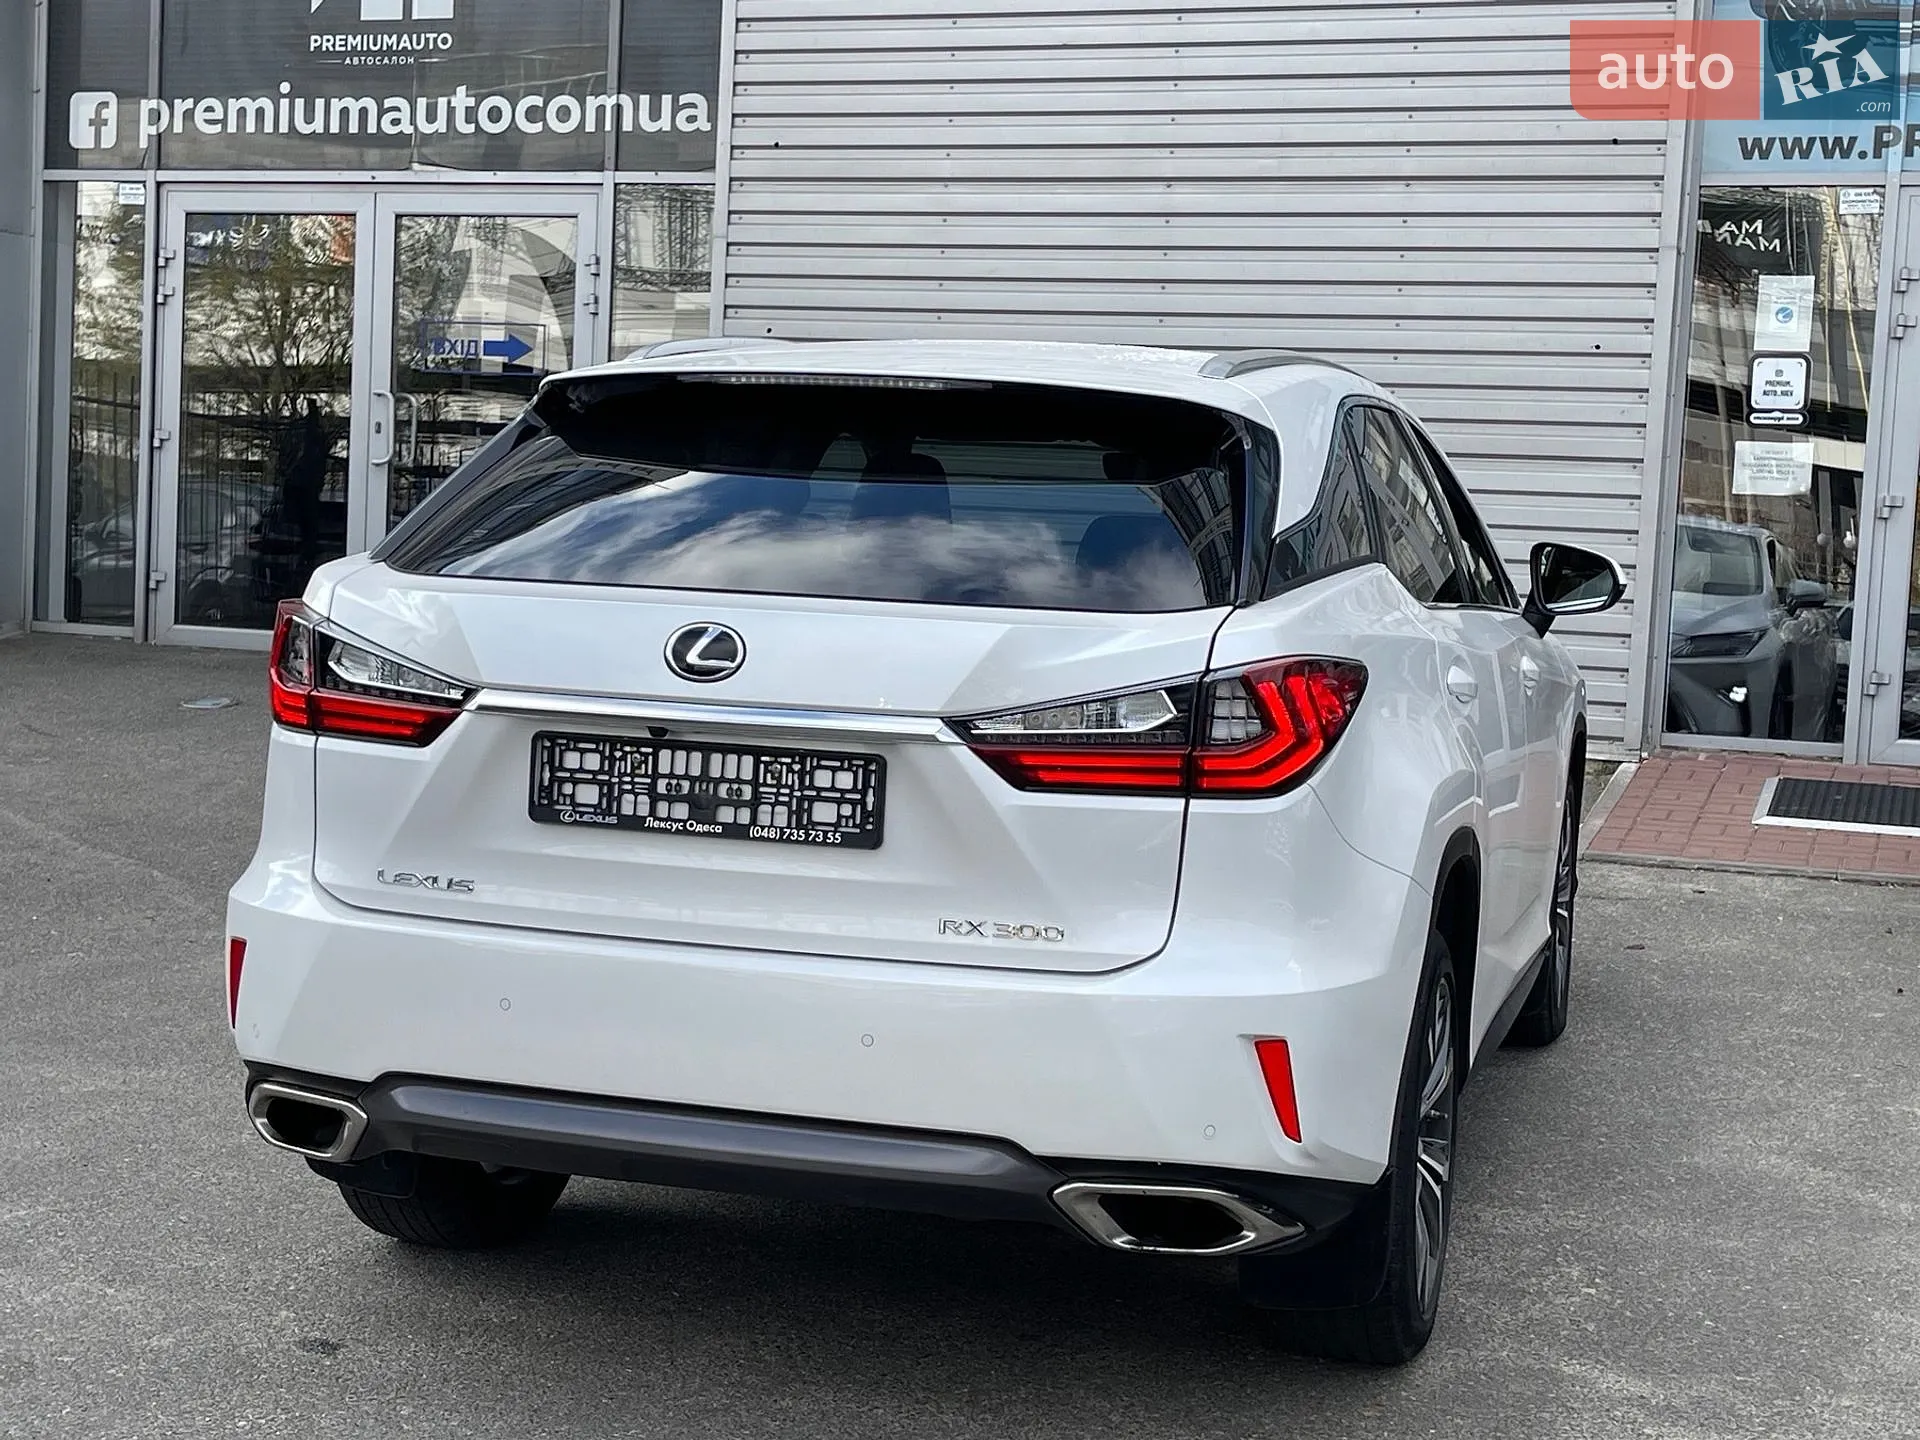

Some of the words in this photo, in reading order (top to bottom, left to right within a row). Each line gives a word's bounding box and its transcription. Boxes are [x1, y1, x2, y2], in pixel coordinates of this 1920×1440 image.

[309, 32, 453, 52] PREMIUMAUTO
[344, 56, 415, 66] АВТОСАЛОН
[138, 81, 712, 149] premiumautocomua
[433, 338, 479, 359] ВХІД
[575, 813, 619, 824] LEXUS
[644, 817, 684, 832] Лексус
[686, 820, 723, 833] Одеса
[749, 826, 781, 841] (048)
[783, 828, 806, 842] 735
[808, 831, 824, 843] 73
[826, 832, 842, 844] 55
[376, 868, 476, 894] LEXUS
[938, 918, 988, 938] RX
[991, 921, 1065, 942] 300
